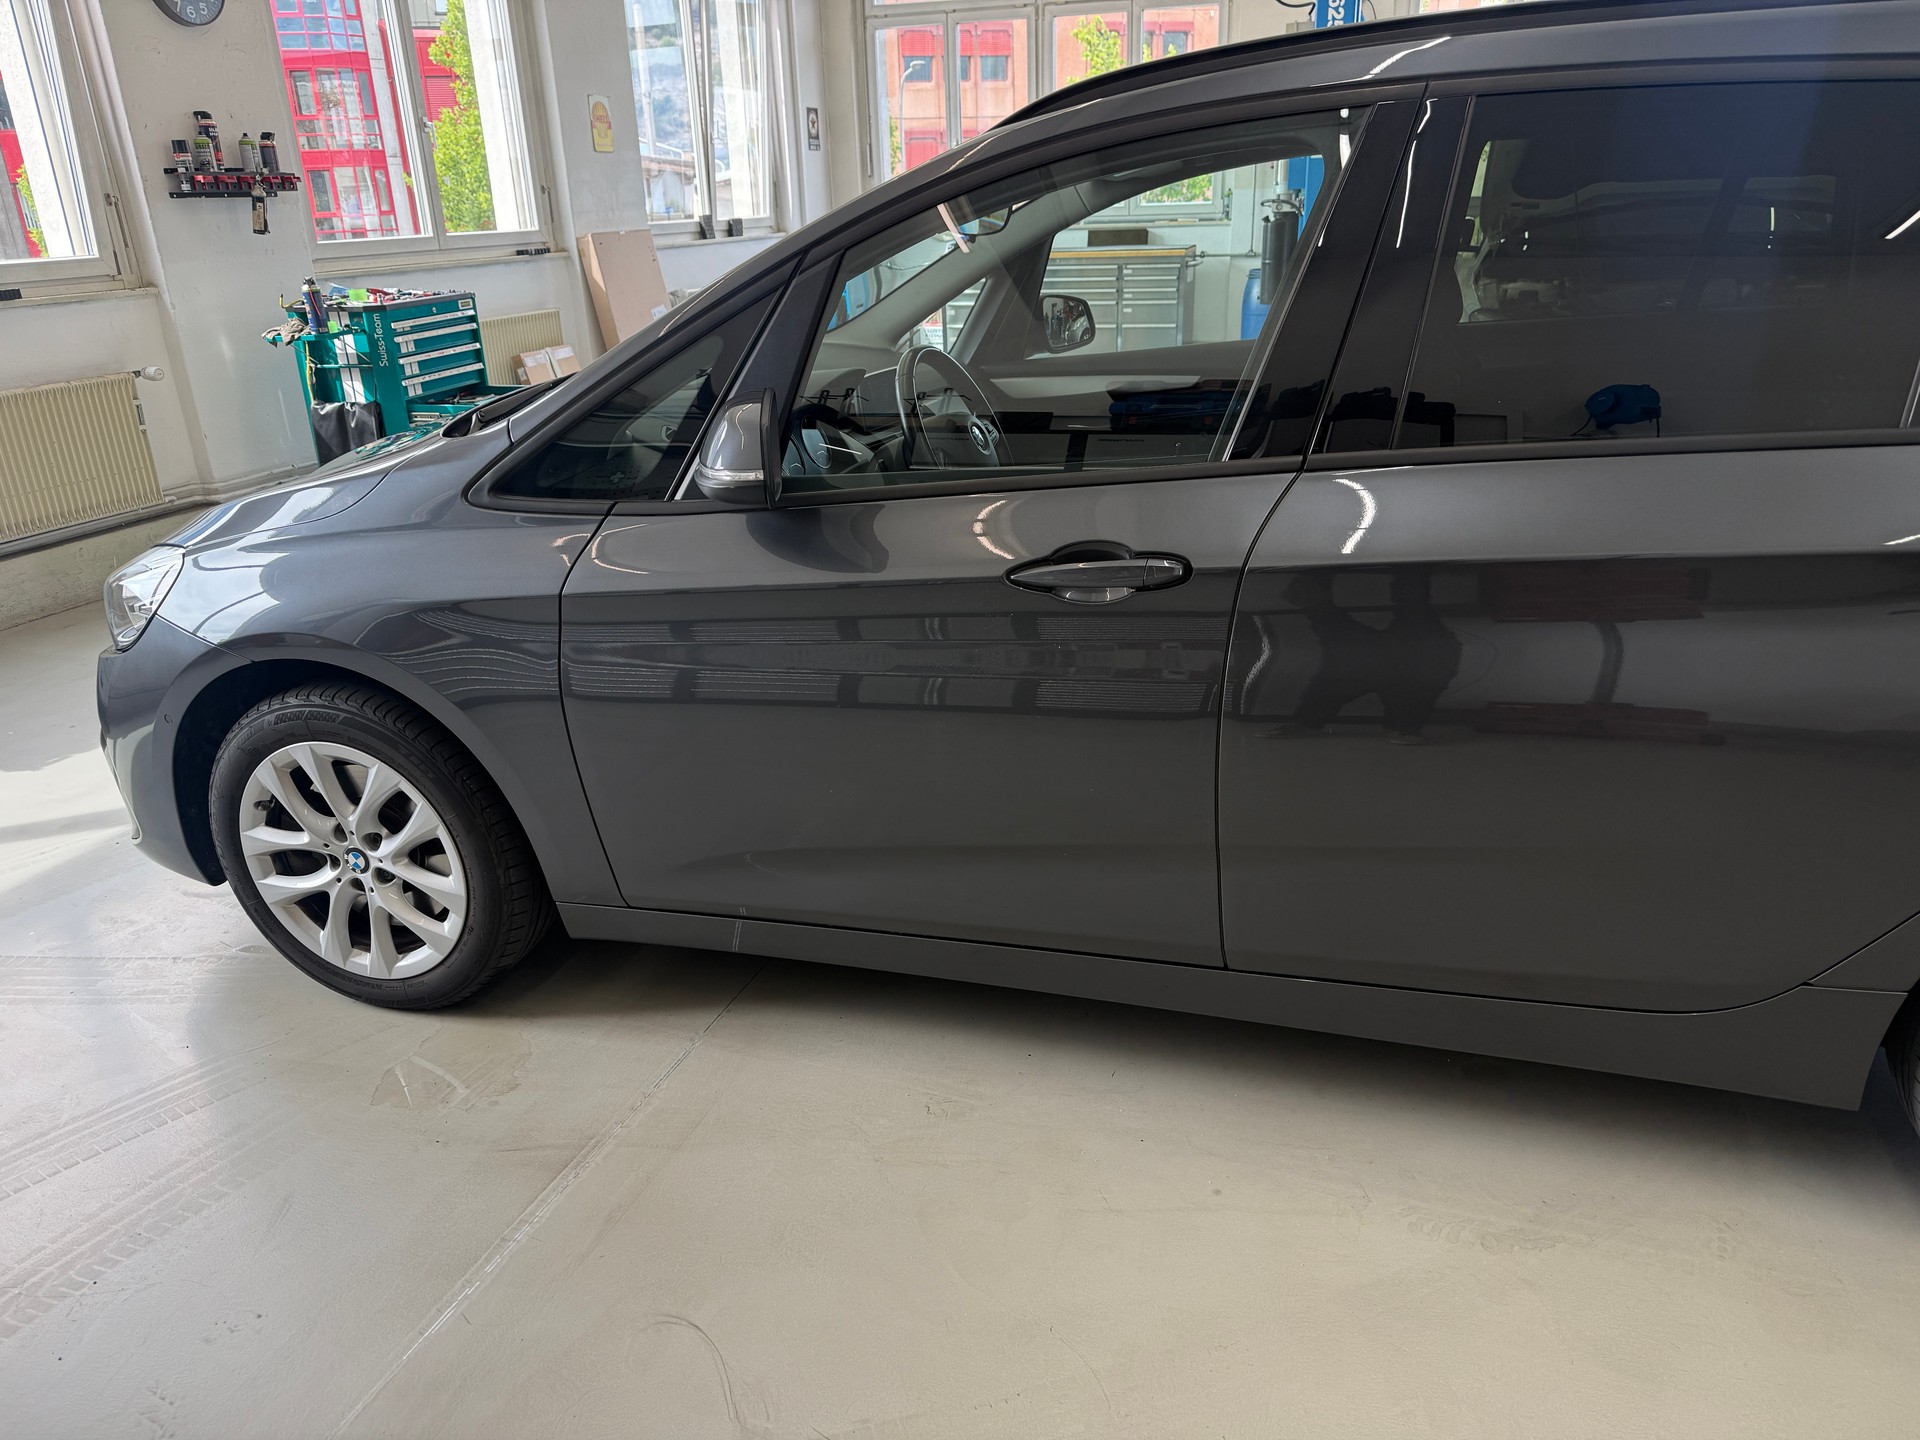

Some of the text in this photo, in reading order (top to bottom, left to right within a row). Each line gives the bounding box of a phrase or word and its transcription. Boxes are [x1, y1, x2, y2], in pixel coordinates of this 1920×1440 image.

[186, 5, 196, 19] 6
[198, 2, 208, 15] 5
[372, 313, 389, 367] Swiss-Team
